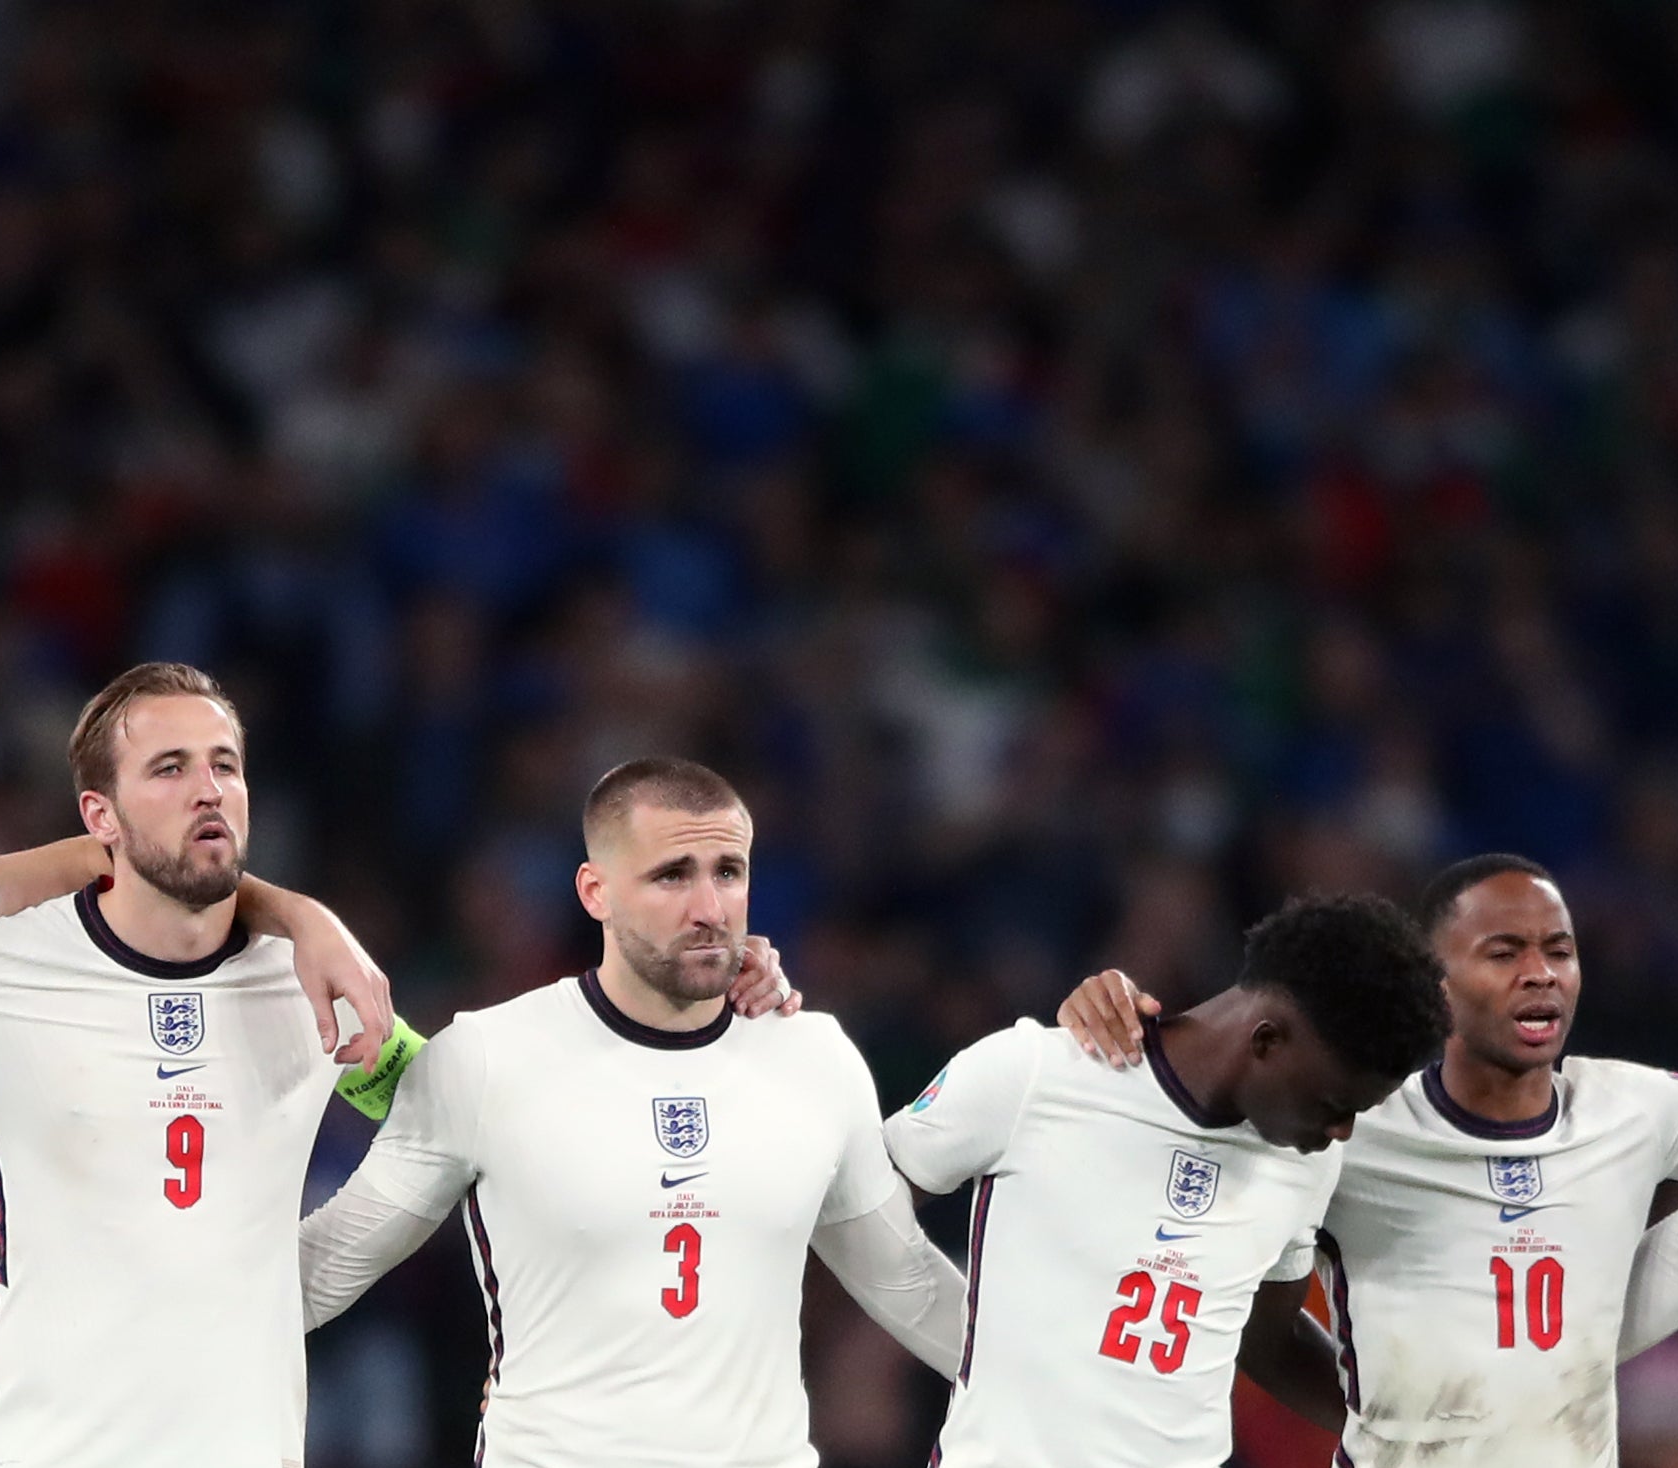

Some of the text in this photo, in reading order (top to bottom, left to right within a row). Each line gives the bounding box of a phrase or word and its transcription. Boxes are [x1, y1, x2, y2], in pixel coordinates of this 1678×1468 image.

[174, 1093, 189, 1101] JULY
[204, 1102, 224, 1110] FINAL
[163, 1112, 206, 1211] 9
[676, 1193, 695, 1201] ITALY
[701, 1210, 720, 1218] FINAL
[660, 1221, 703, 1320] 3
[1098, 1269, 1204, 1376] 25
[1488, 1255, 1566, 1353] 10
